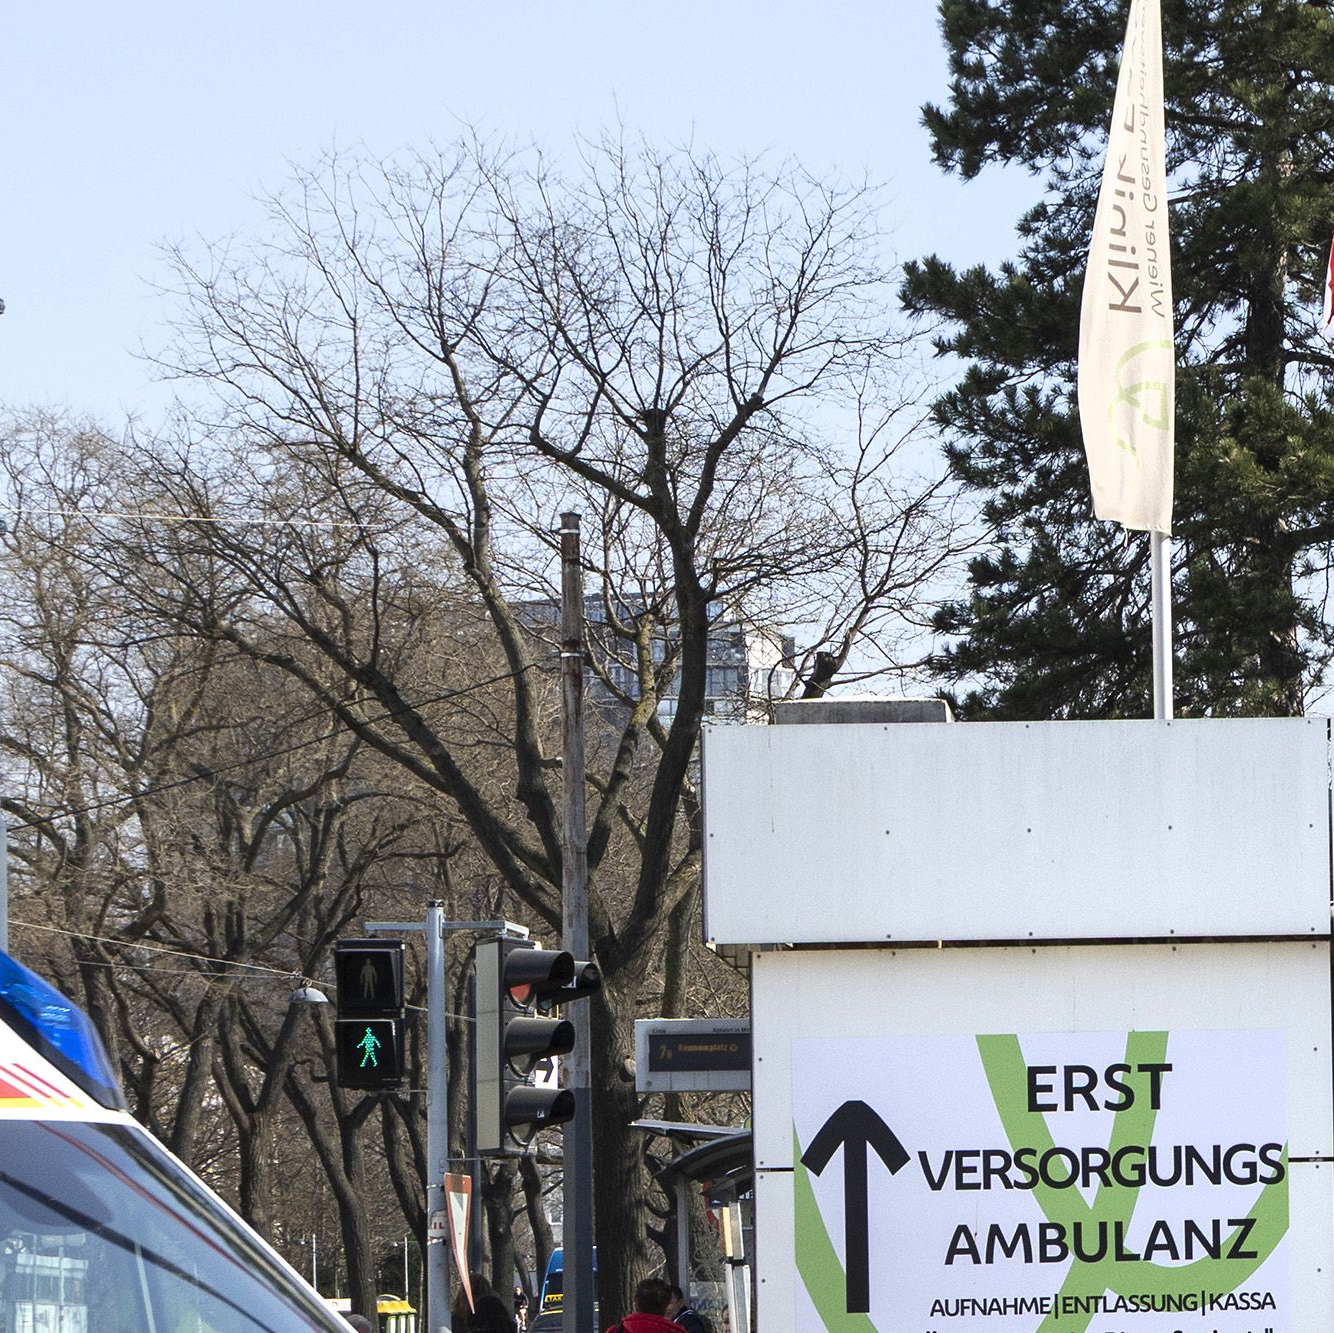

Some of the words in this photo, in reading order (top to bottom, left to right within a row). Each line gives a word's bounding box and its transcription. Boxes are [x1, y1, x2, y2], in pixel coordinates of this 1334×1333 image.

[1027, 1063, 1173, 1112] ERST
[918, 1142, 1285, 1191] VERSORGUNGS
[944, 1218, 1258, 1265] AMBULANZ
